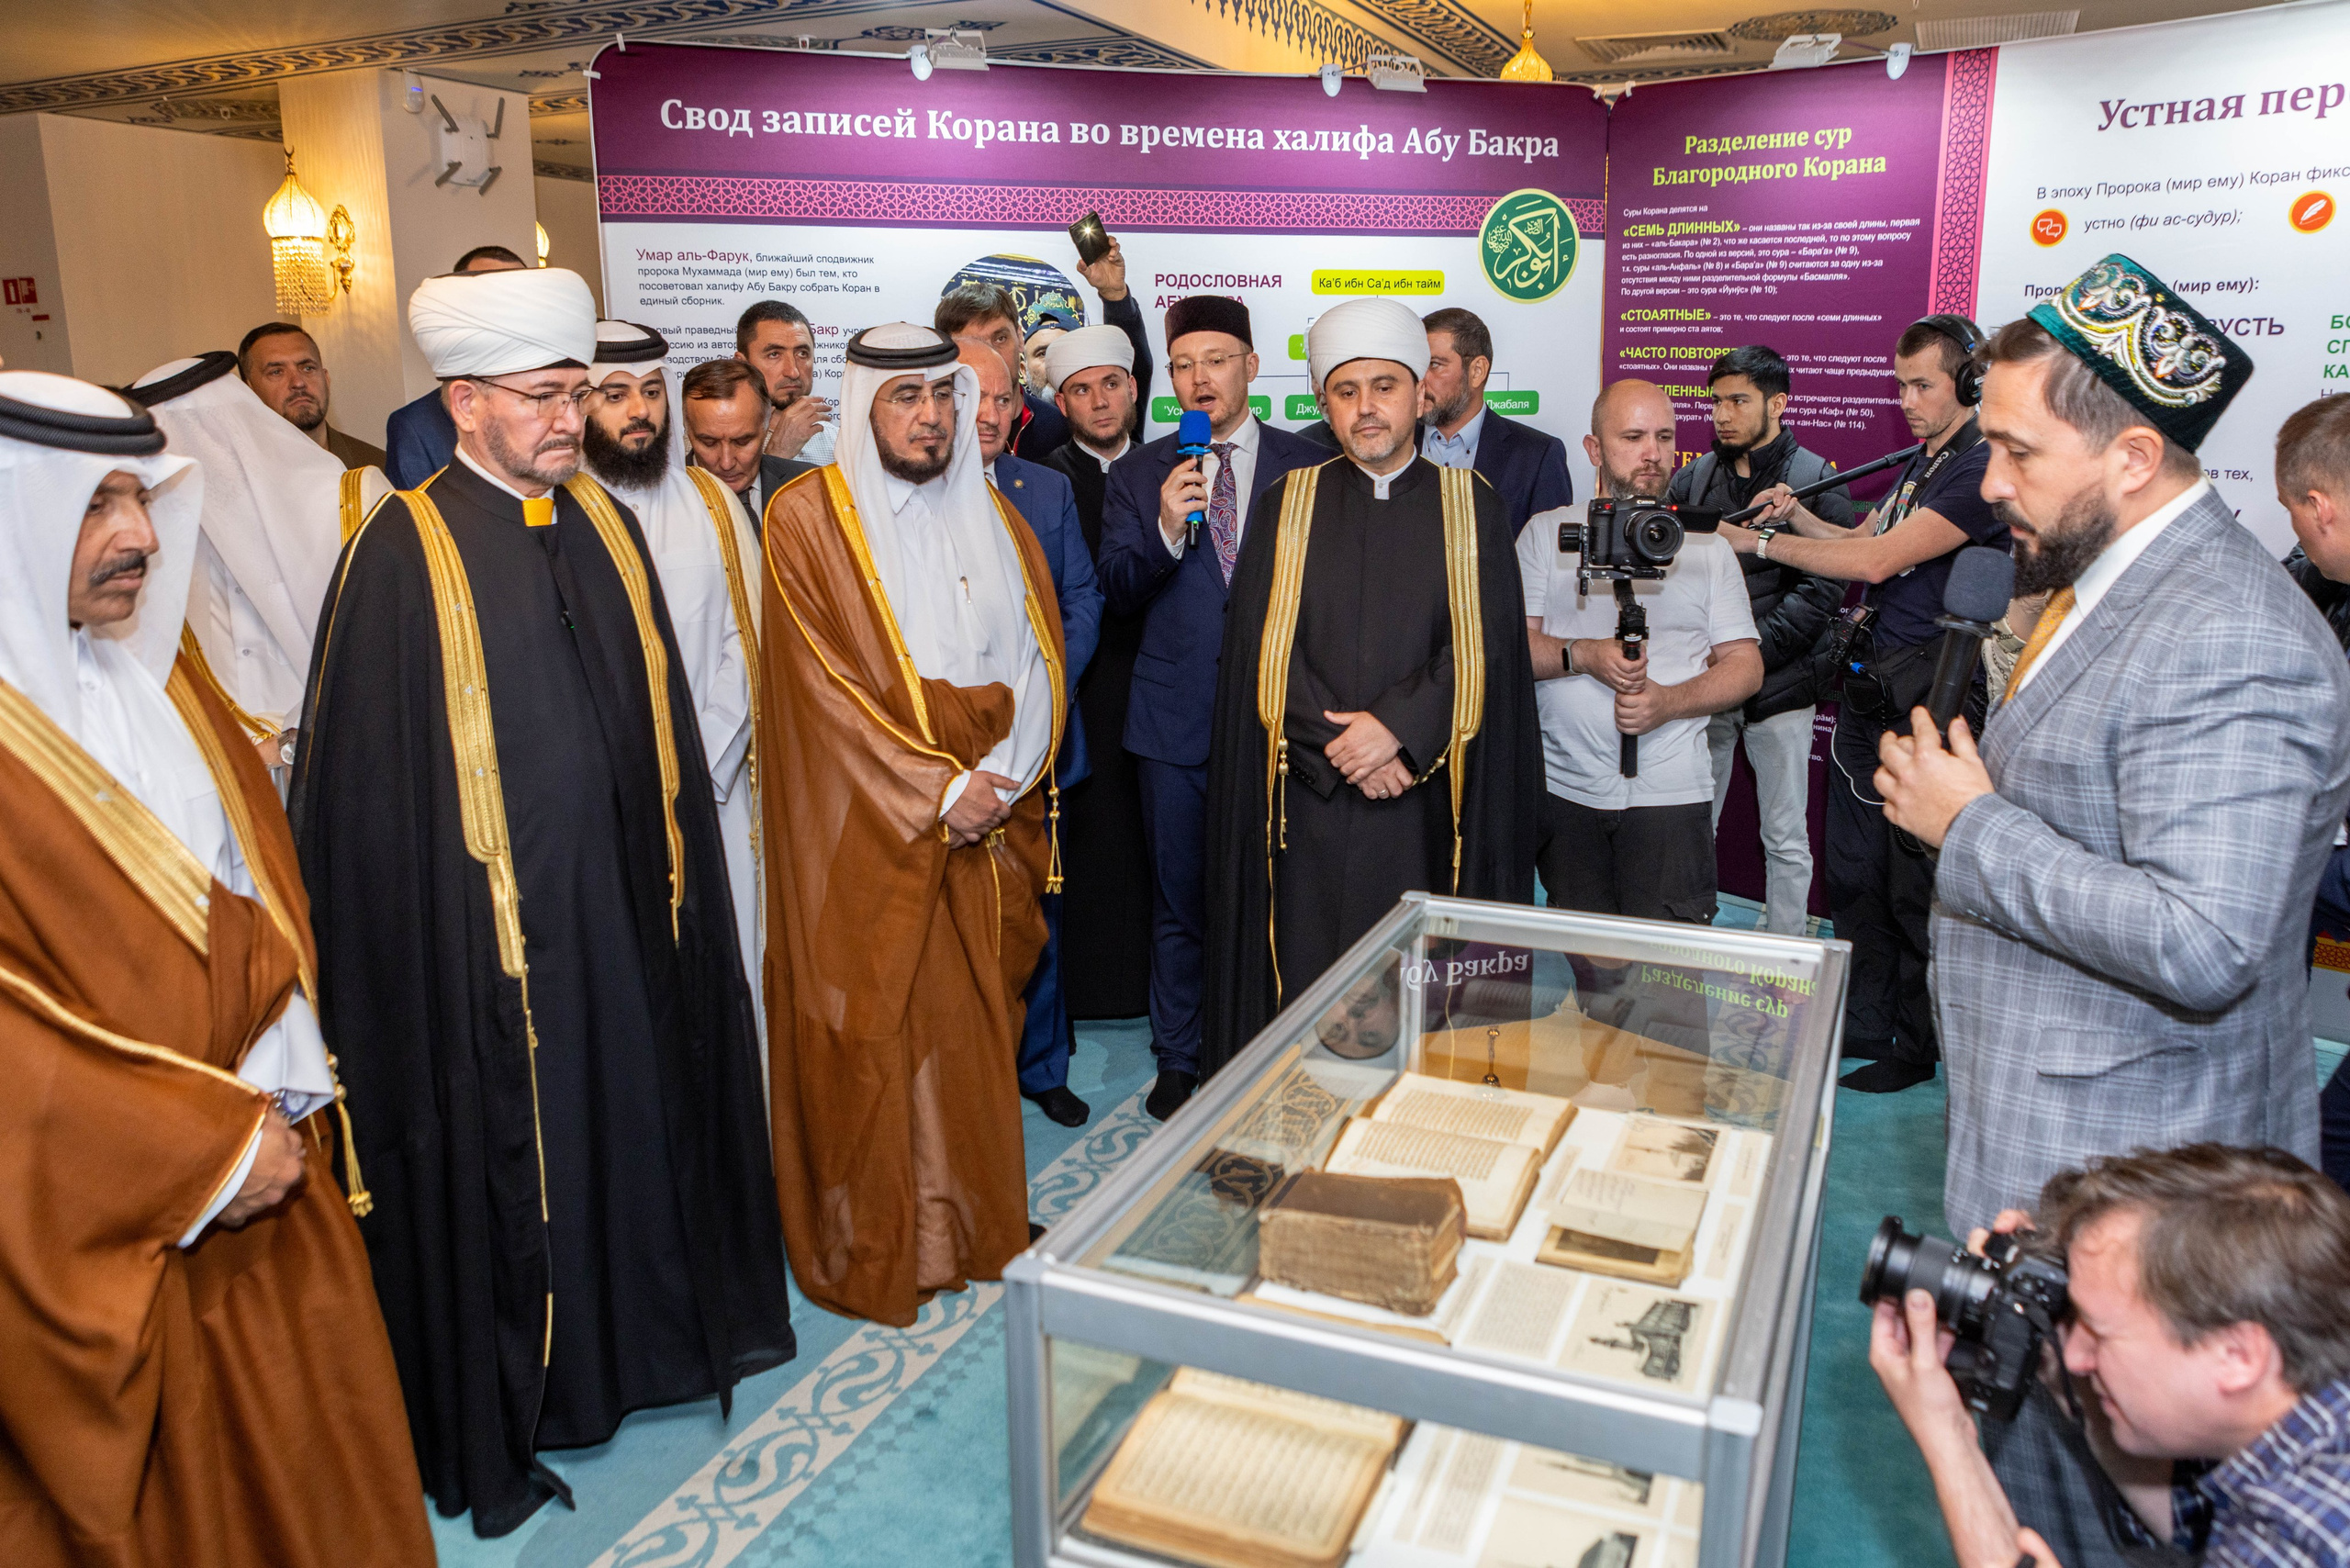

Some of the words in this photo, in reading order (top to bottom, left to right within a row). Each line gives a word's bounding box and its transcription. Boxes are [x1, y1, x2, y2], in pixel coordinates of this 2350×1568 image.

[2098, 94, 2246, 131] Устная
[2258, 83, 2350, 119] пер
[660, 98, 754, 139] Свод
[762, 107, 917, 139] записей
[927, 109, 1060, 149] Корана
[1069, 122, 1110, 144] во
[1120, 124, 1265, 154] времена
[1272, 125, 1394, 161] халифа
[1402, 127, 1461, 162] Абу
[1468, 129, 1559, 163] Бакра
[1684, 129, 1808, 155] Разделение
[1814, 127, 1852, 149] сур
[1652, 161, 1797, 187] Благородного
[1803, 155, 1886, 180] Корана
[2037, 187, 2046, 199] В
[2051, 185, 2092, 200] эпоху
[2097, 181, 2161, 199] Пророка
[2165, 177, 2202, 194] (мир
[2207, 174, 2244, 190] ему)
[2250, 170, 2300, 186] Коран
[2306, 166, 2350, 184] фикс
[1624, 208, 1641, 217] Суры
[1643, 207, 1668, 216] Корана
[1669, 206, 1697, 215] делятся
[1623, 224, 1664, 237] «СЕМЬ
[1667, 220, 1740, 237] ДЛИННЫХ»
[1764, 223, 1796, 231] названы
[1834, 219, 1858, 230] своей
[1890, 218, 1920, 229] первая
[2083, 217, 2125, 233] устно
[2130, 214, 2158, 230] (фи
[2163, 209, 2243, 228] ас-судур);
[1750, 236, 1782, 244] касается
[1852, 233, 1875, 242] этому
[1877, 231, 1911, 241] вопросу
[636, 248, 672, 263] Умар
[677, 250, 753, 264] аль-Фарук,
[755, 252, 813, 263] ближайший
[816, 255, 874, 265] сподвижник
[1684, 250, 1694, 258] По
[1695, 249, 1717, 259] одной
[1758, 249, 1770, 257] это
[1772, 249, 1789, 258] сура
[638, 267, 679, 278] пророка
[683, 267, 742, 278] Мухаммада
[744, 267, 767, 279] (мир
[771, 268, 793, 280] ему)
[796, 268, 815, 277] был
[819, 270, 840, 279] тем,
[843, 270, 857, 278] кто
[1633, 264, 1650, 274] суры
[1789, 261, 1828, 269] считаются
[1841, 260, 1860, 269] одну
[1862, 259, 1883, 267] из-за
[1155, 274, 1281, 289] РОДОСЛОВНАЯ
[1345, 277, 1363, 288] ибн
[1393, 278, 1413, 288] ибн
[1416, 279, 1441, 288] тайм
[1621, 277, 1657, 286] отсутствия
[1659, 276, 1681, 285] между
[1702, 273, 1761, 284] разделительной
[1762, 274, 1797, 283] формулы
[2173, 280, 2211, 294] (мир
[2216, 277, 2259, 293] ему):
[639, 282, 703, 291] посоветовал
[706, 282, 744, 293] халифу
[746, 282, 766, 293] Абу
[768, 283, 797, 294] Бакру
[800, 283, 839, 295] собрать
[843, 284, 871, 295] Коран
[1621, 287, 1630, 296] По
[1632, 287, 1654, 297] другой
[640, 297, 678, 306] единый
[681, 297, 725, 308] сборник.
[1620, 308, 1711, 321] «СТОАЯТНЫЕ»
[1759, 314, 1790, 322] следуют
[1841, 314, 1882, 322] длинных»
[1619, 347, 1667, 359] «ЧАСТО
[1828, 355, 1862, 364] следуют
[1663, 363, 1677, 371] Они
[1924, 451, 1950, 478] Canon
[2224, 469, 2254, 482] тех,
